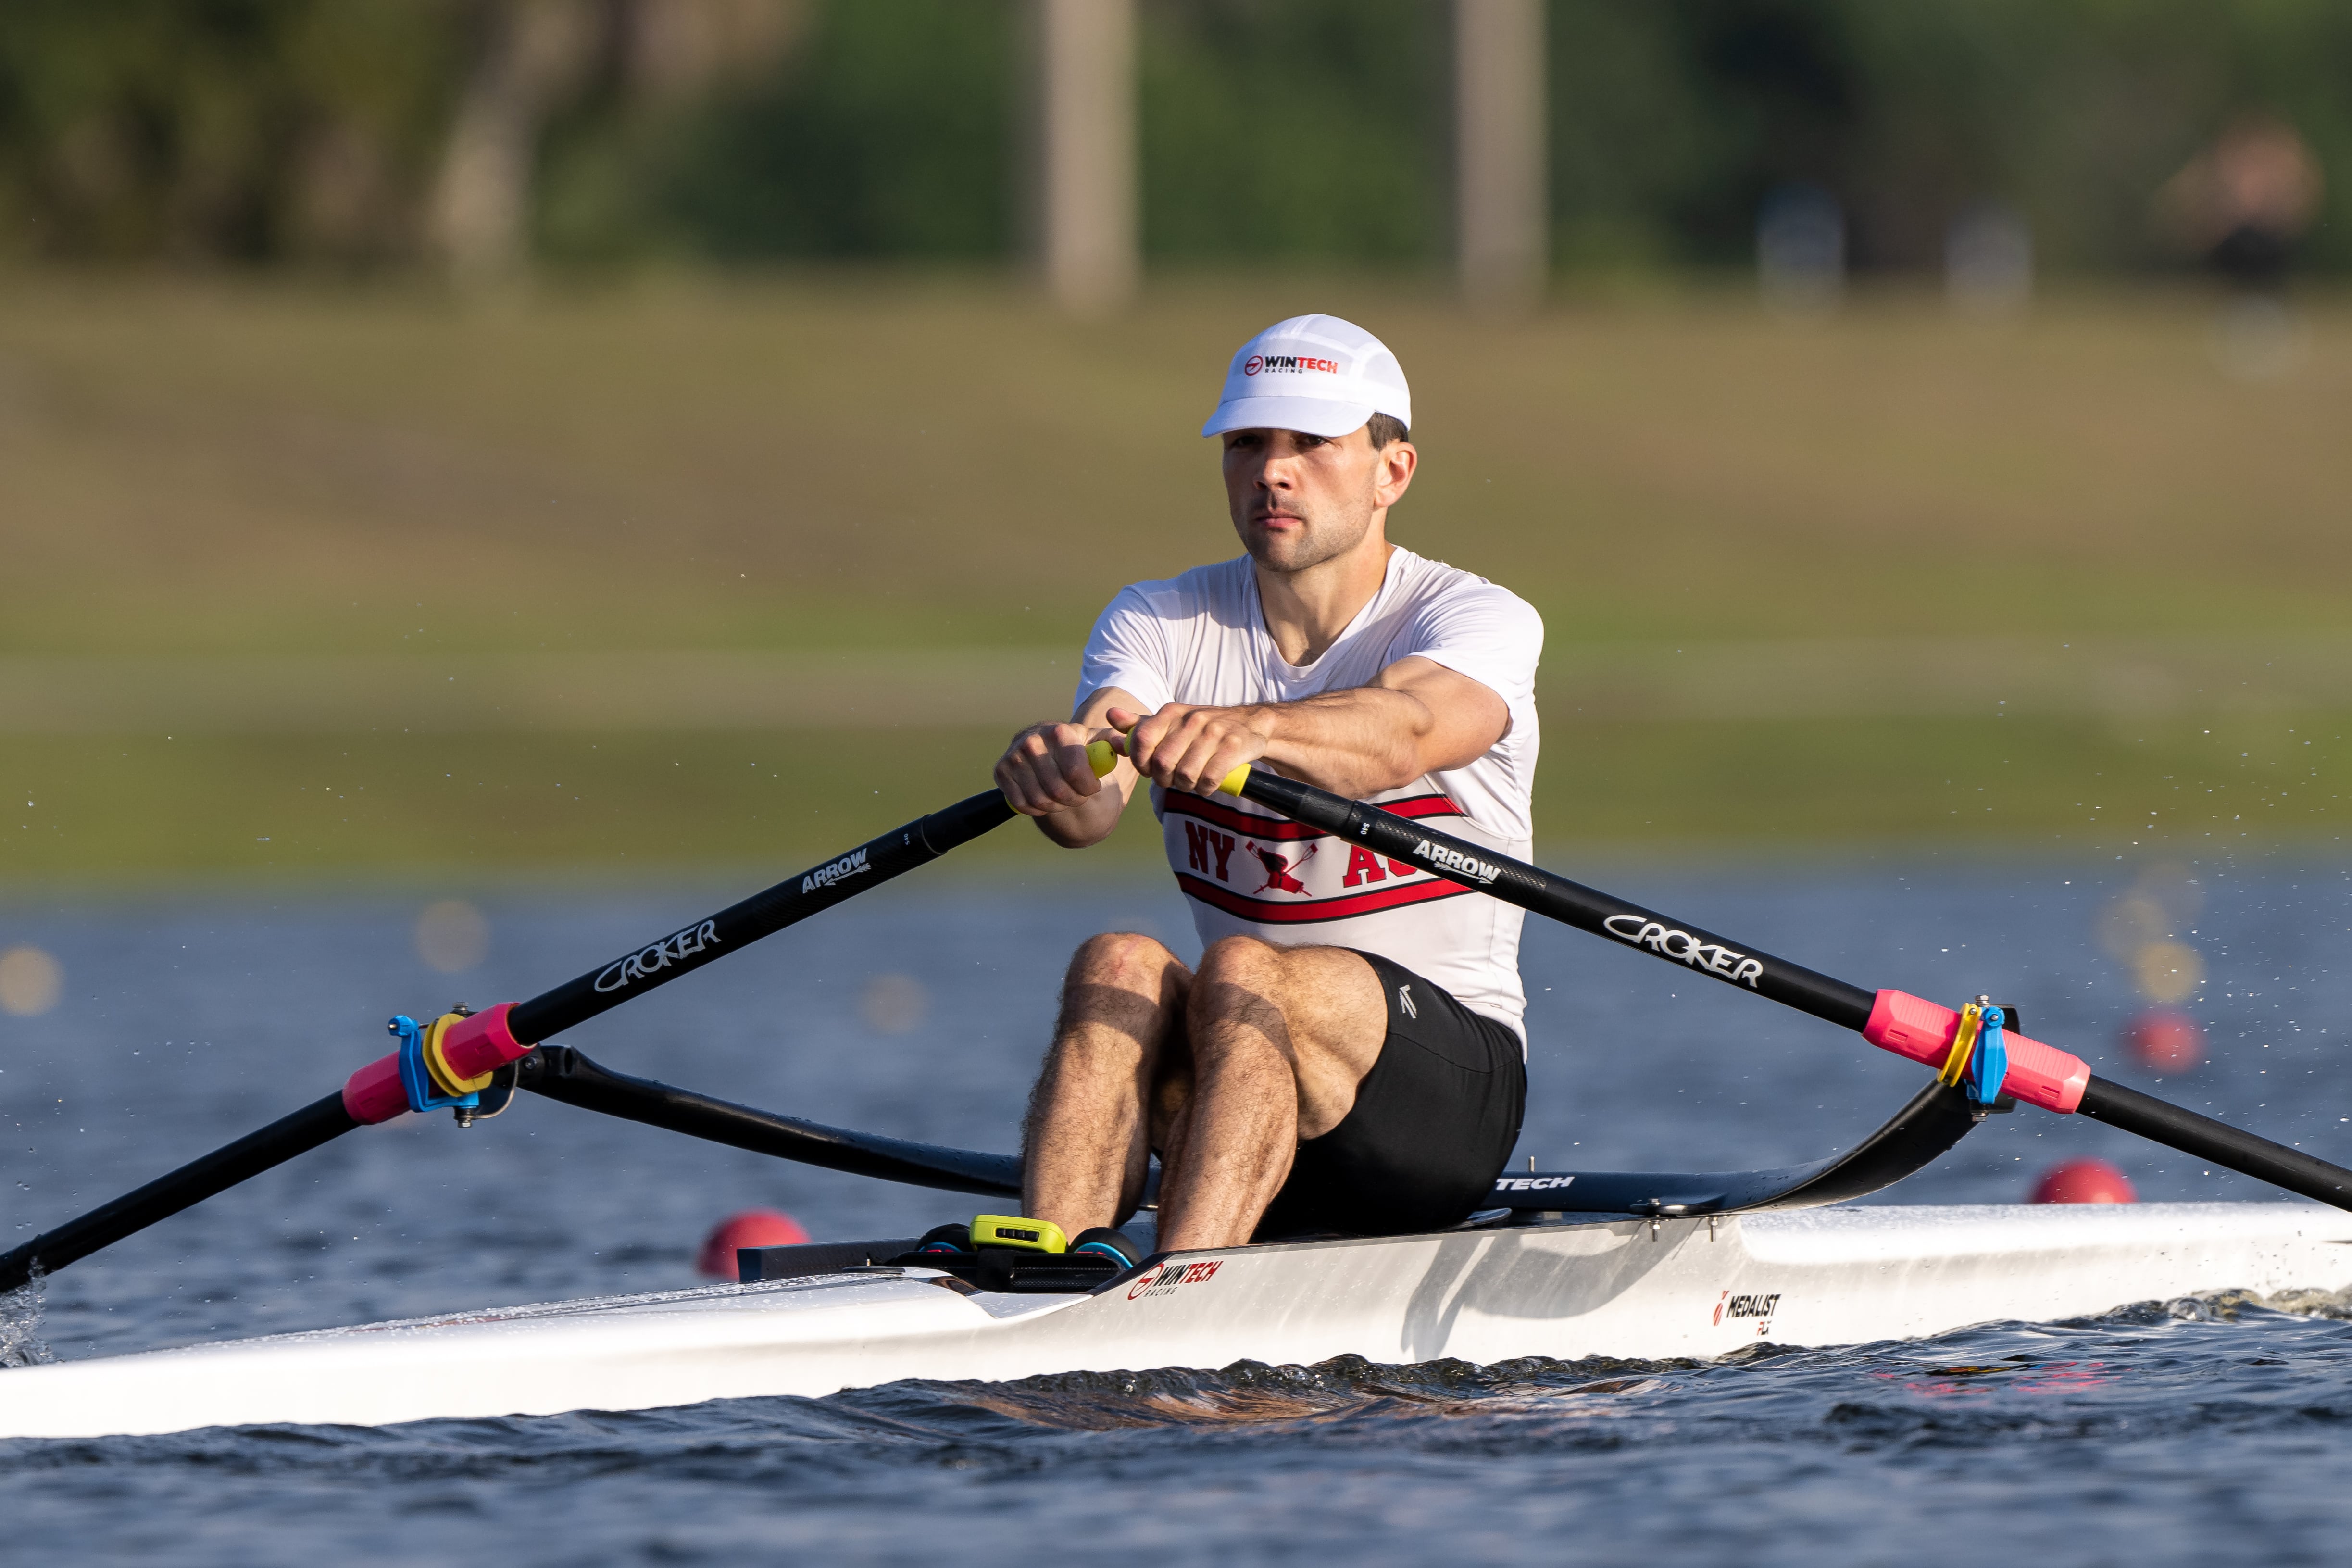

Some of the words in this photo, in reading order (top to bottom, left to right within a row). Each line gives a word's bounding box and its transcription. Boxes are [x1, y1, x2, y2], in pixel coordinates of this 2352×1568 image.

[1265, 356, 1338, 374] WINTECH
[802, 848, 867, 894] ARROW
[1185, 820, 1235, 883] NY
[1413, 840, 1501, 882] ARROW
[594, 920, 721, 992] CROKER
[1603, 915, 1764, 988] CROKER
[1144, 1287, 1177, 1297] RACING
[1152, 1261, 1224, 1287] WINTECH
[1726, 1294, 1781, 1317] MEDALIST
